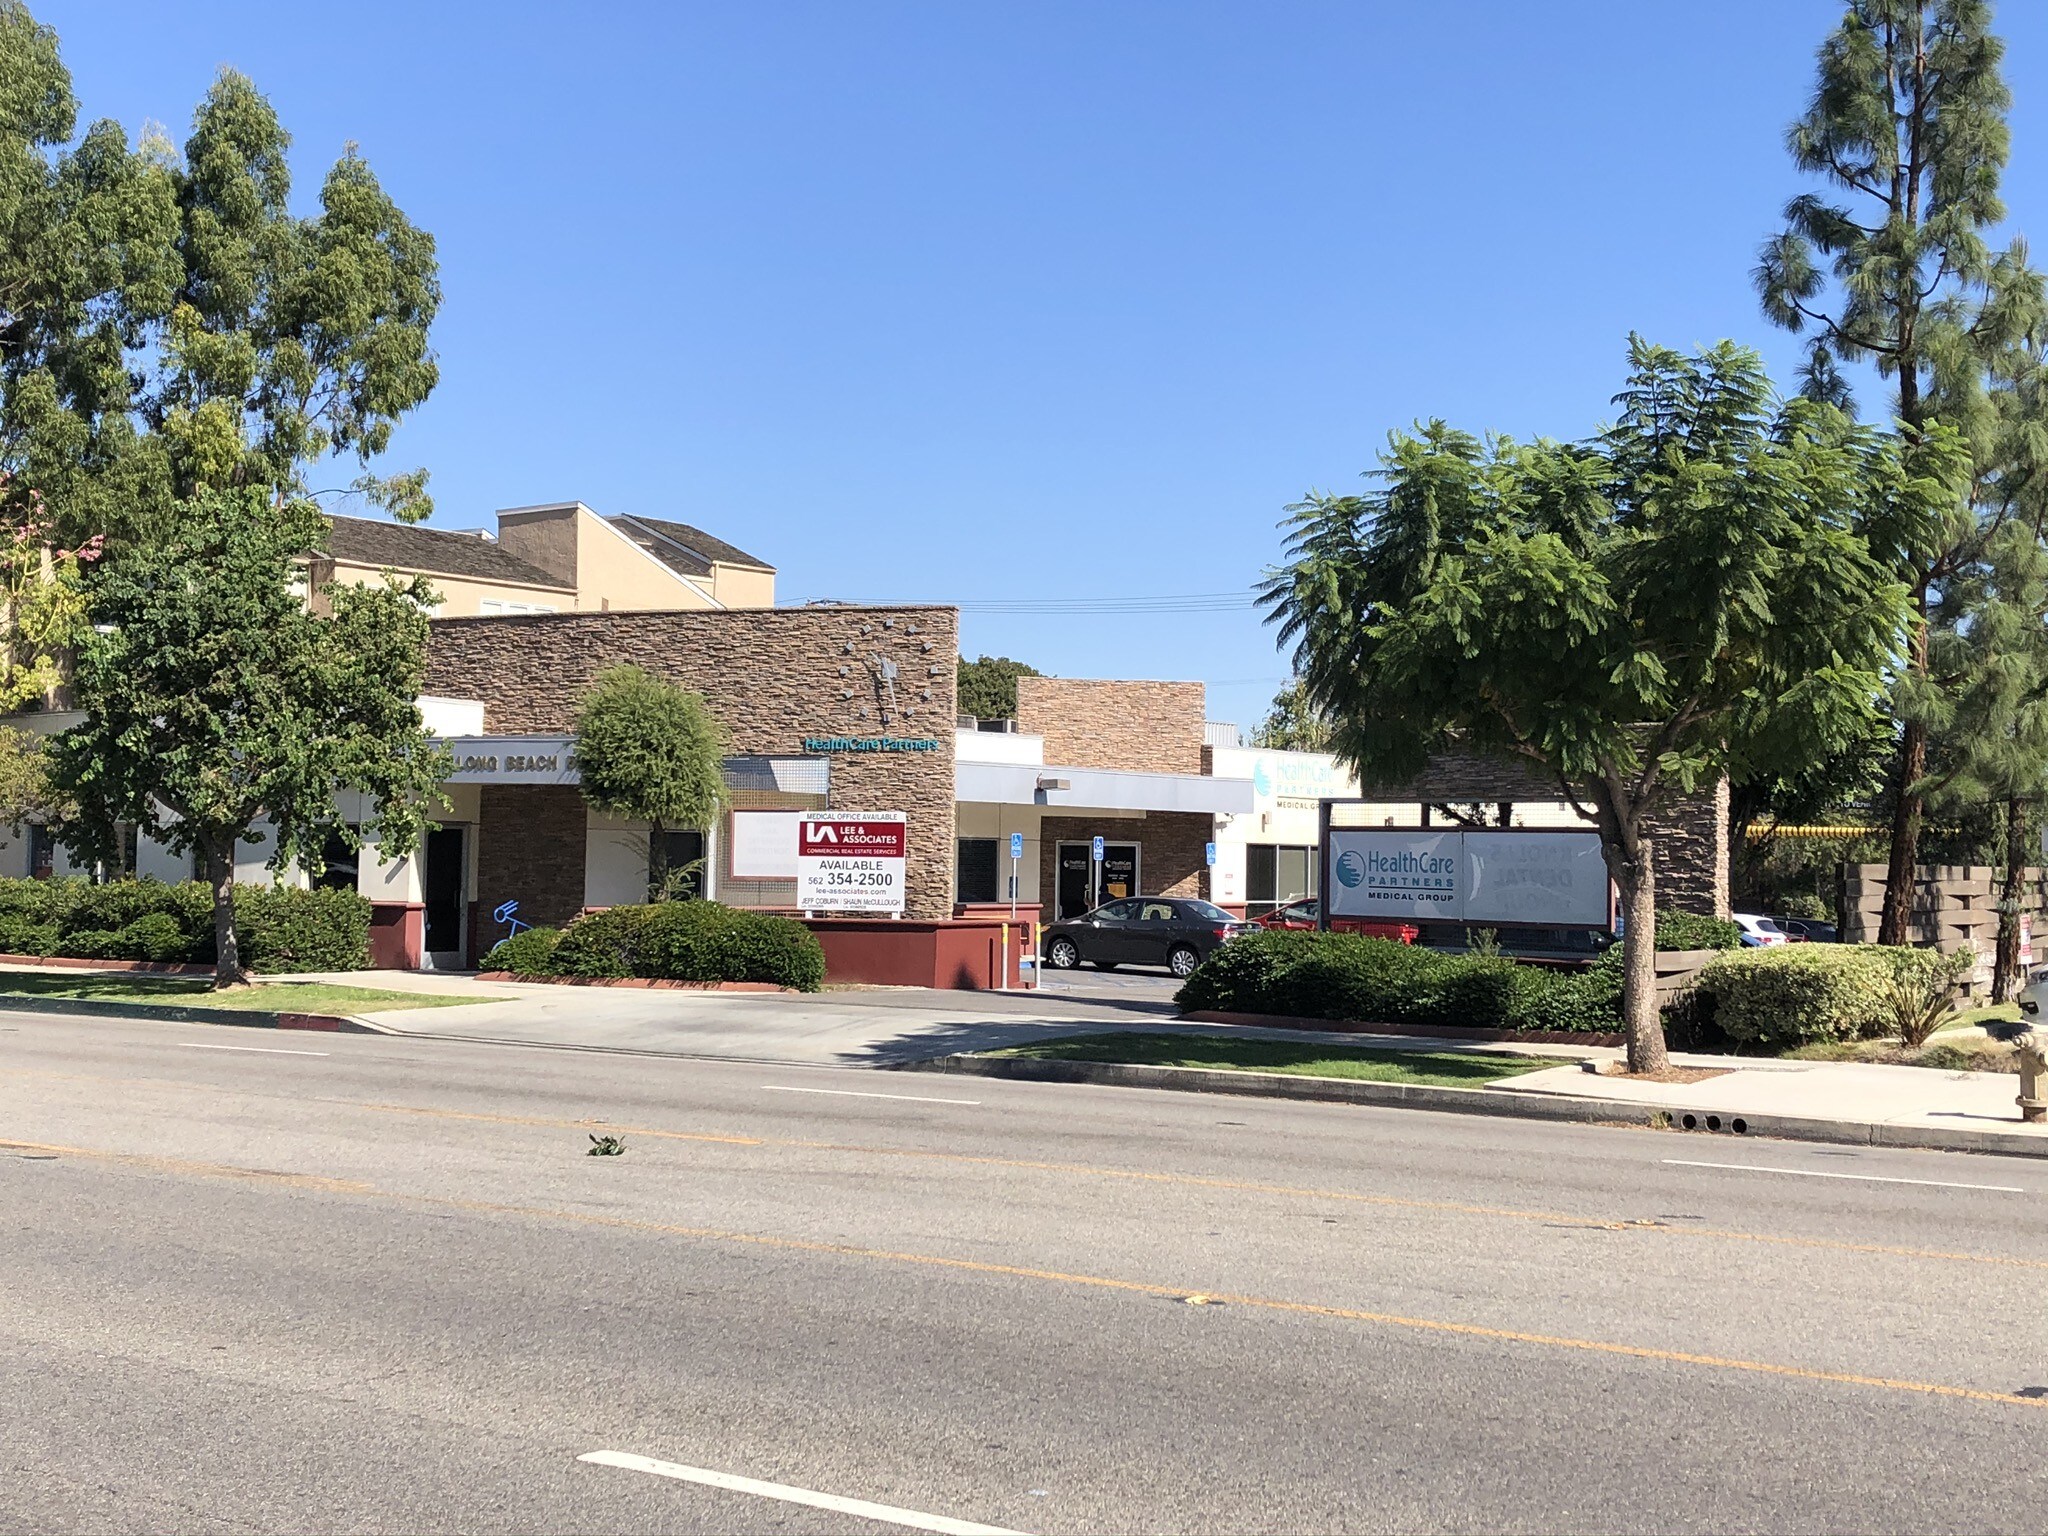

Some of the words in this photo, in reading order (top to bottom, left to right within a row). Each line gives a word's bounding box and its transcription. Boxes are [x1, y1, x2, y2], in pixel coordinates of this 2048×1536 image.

[805, 738, 880, 751] HealthCare
[882, 737, 939, 751] Partners
[505, 755, 558, 773] BEACH
[1277, 801, 1308, 809] MEDICAL
[840, 827, 856, 835] LEE
[858, 827, 865, 835] &
[842, 835, 897, 844] ASSOCIATES
[819, 861, 883, 871] AVAILABLE
[1368, 850, 1454, 874] HealthCare
[808, 877, 824, 885] 562
[828, 873, 893, 886] 354-2500
[1368, 876, 1454, 888] PARTNERS
[816, 887, 887, 896] lee-associates.com
[1368, 892, 1414, 900] MEDICAL
[1418, 893, 1454, 902] GROUP
